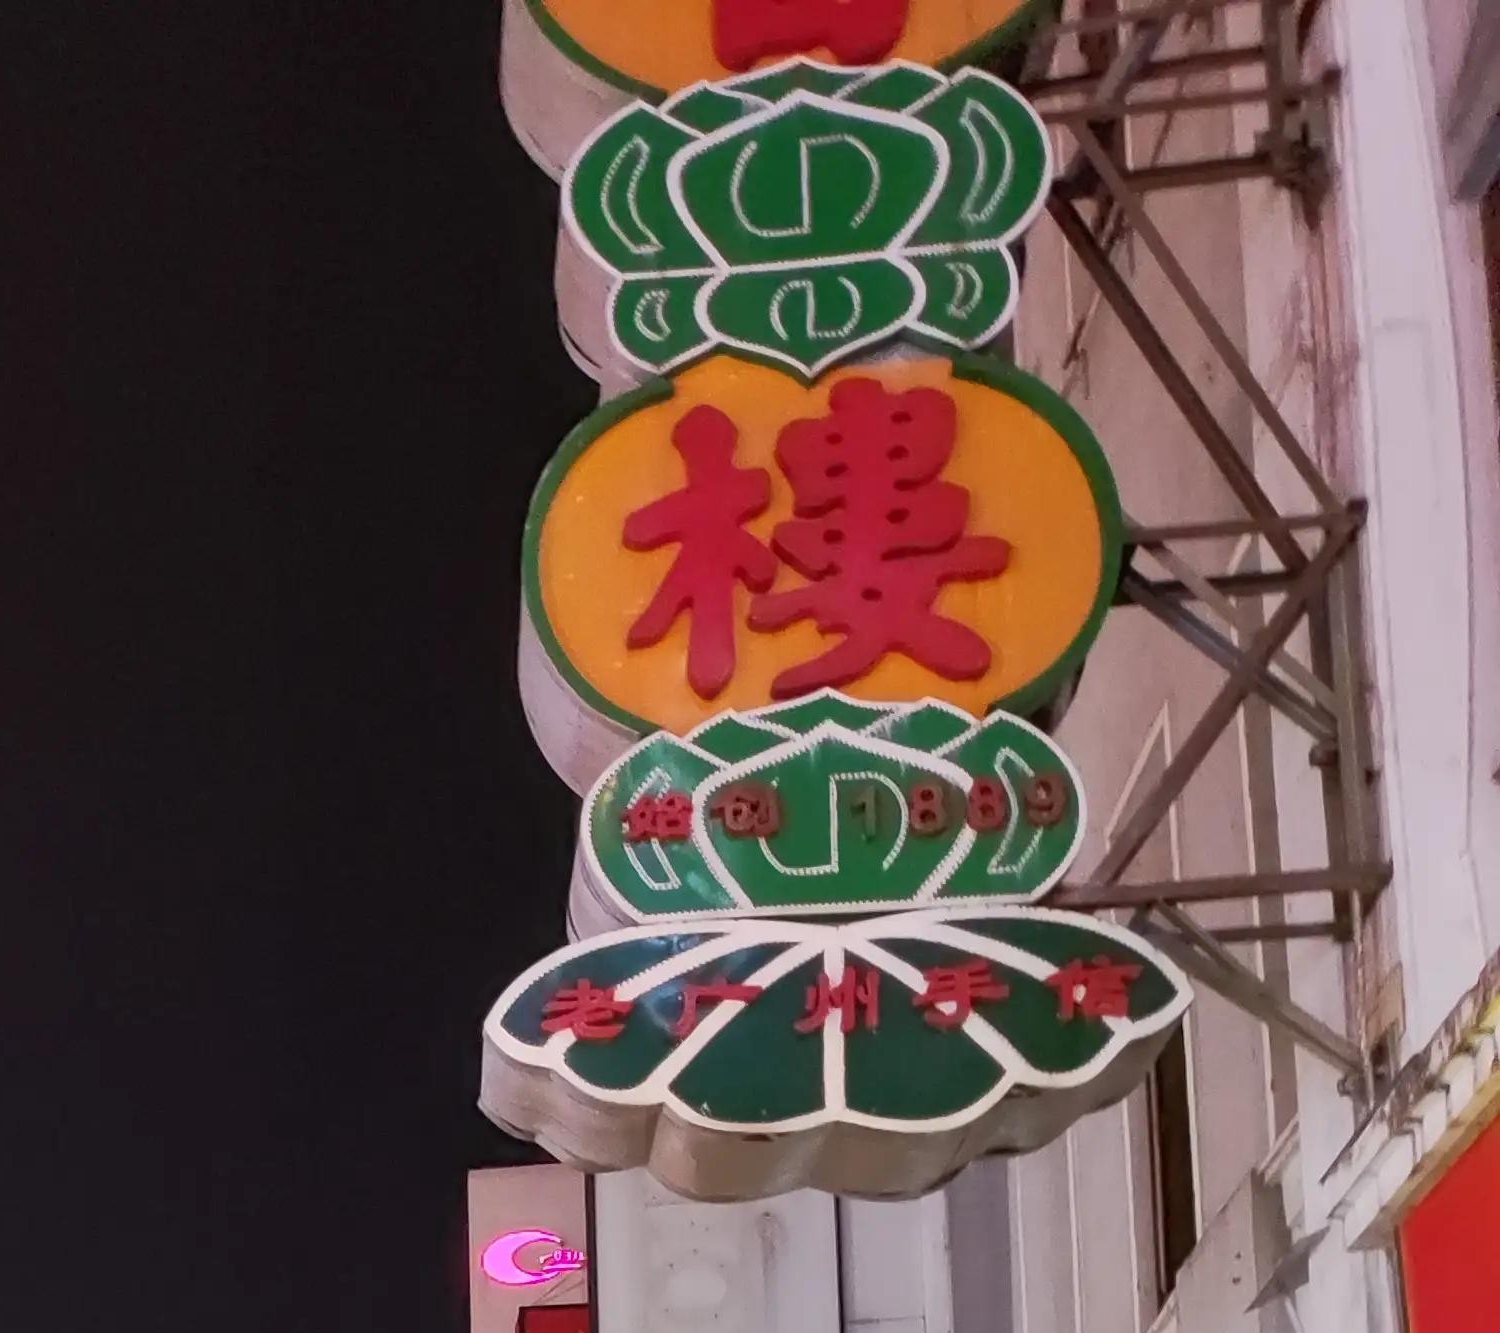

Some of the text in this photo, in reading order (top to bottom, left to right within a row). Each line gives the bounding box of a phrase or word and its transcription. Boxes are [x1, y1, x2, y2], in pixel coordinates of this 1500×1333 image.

[848, 773, 1068, 844] 1889
[541, 957, 1142, 1042] 老广州手信
